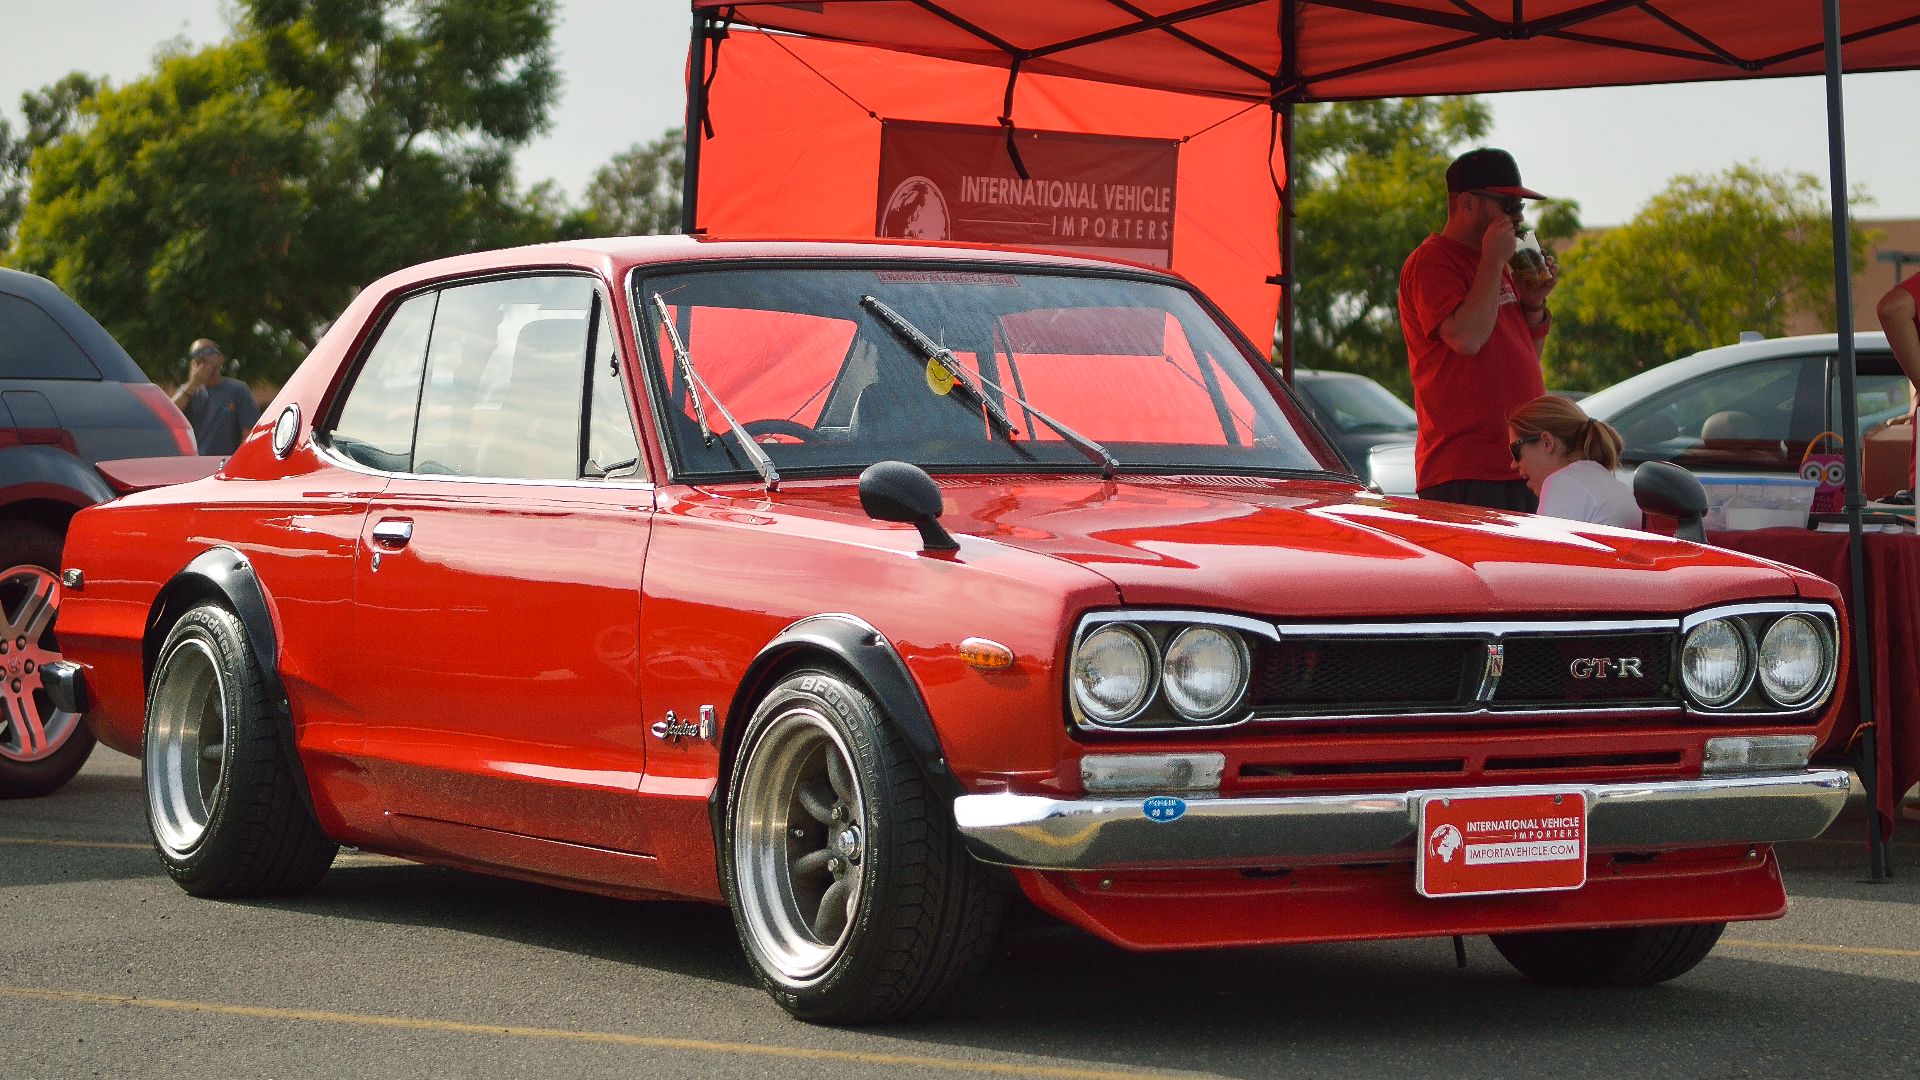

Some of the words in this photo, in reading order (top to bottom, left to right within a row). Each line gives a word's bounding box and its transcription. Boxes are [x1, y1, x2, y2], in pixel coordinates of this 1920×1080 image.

[961, 175, 1098, 209] INTERNATIONAL
[1104, 184, 1170, 213] VEHICLE
[1052, 215, 1168, 241] IMPORTERS
[1570, 657, 1643, 679] GT-R
[1467, 820, 1538, 832] INTERNATIONAL
[1541, 816, 1579, 829] VEHICLE
[1513, 829, 1579, 839] IMPORTERS
[1470, 844, 1575, 859] IMPORTAVEHICLE.COM
